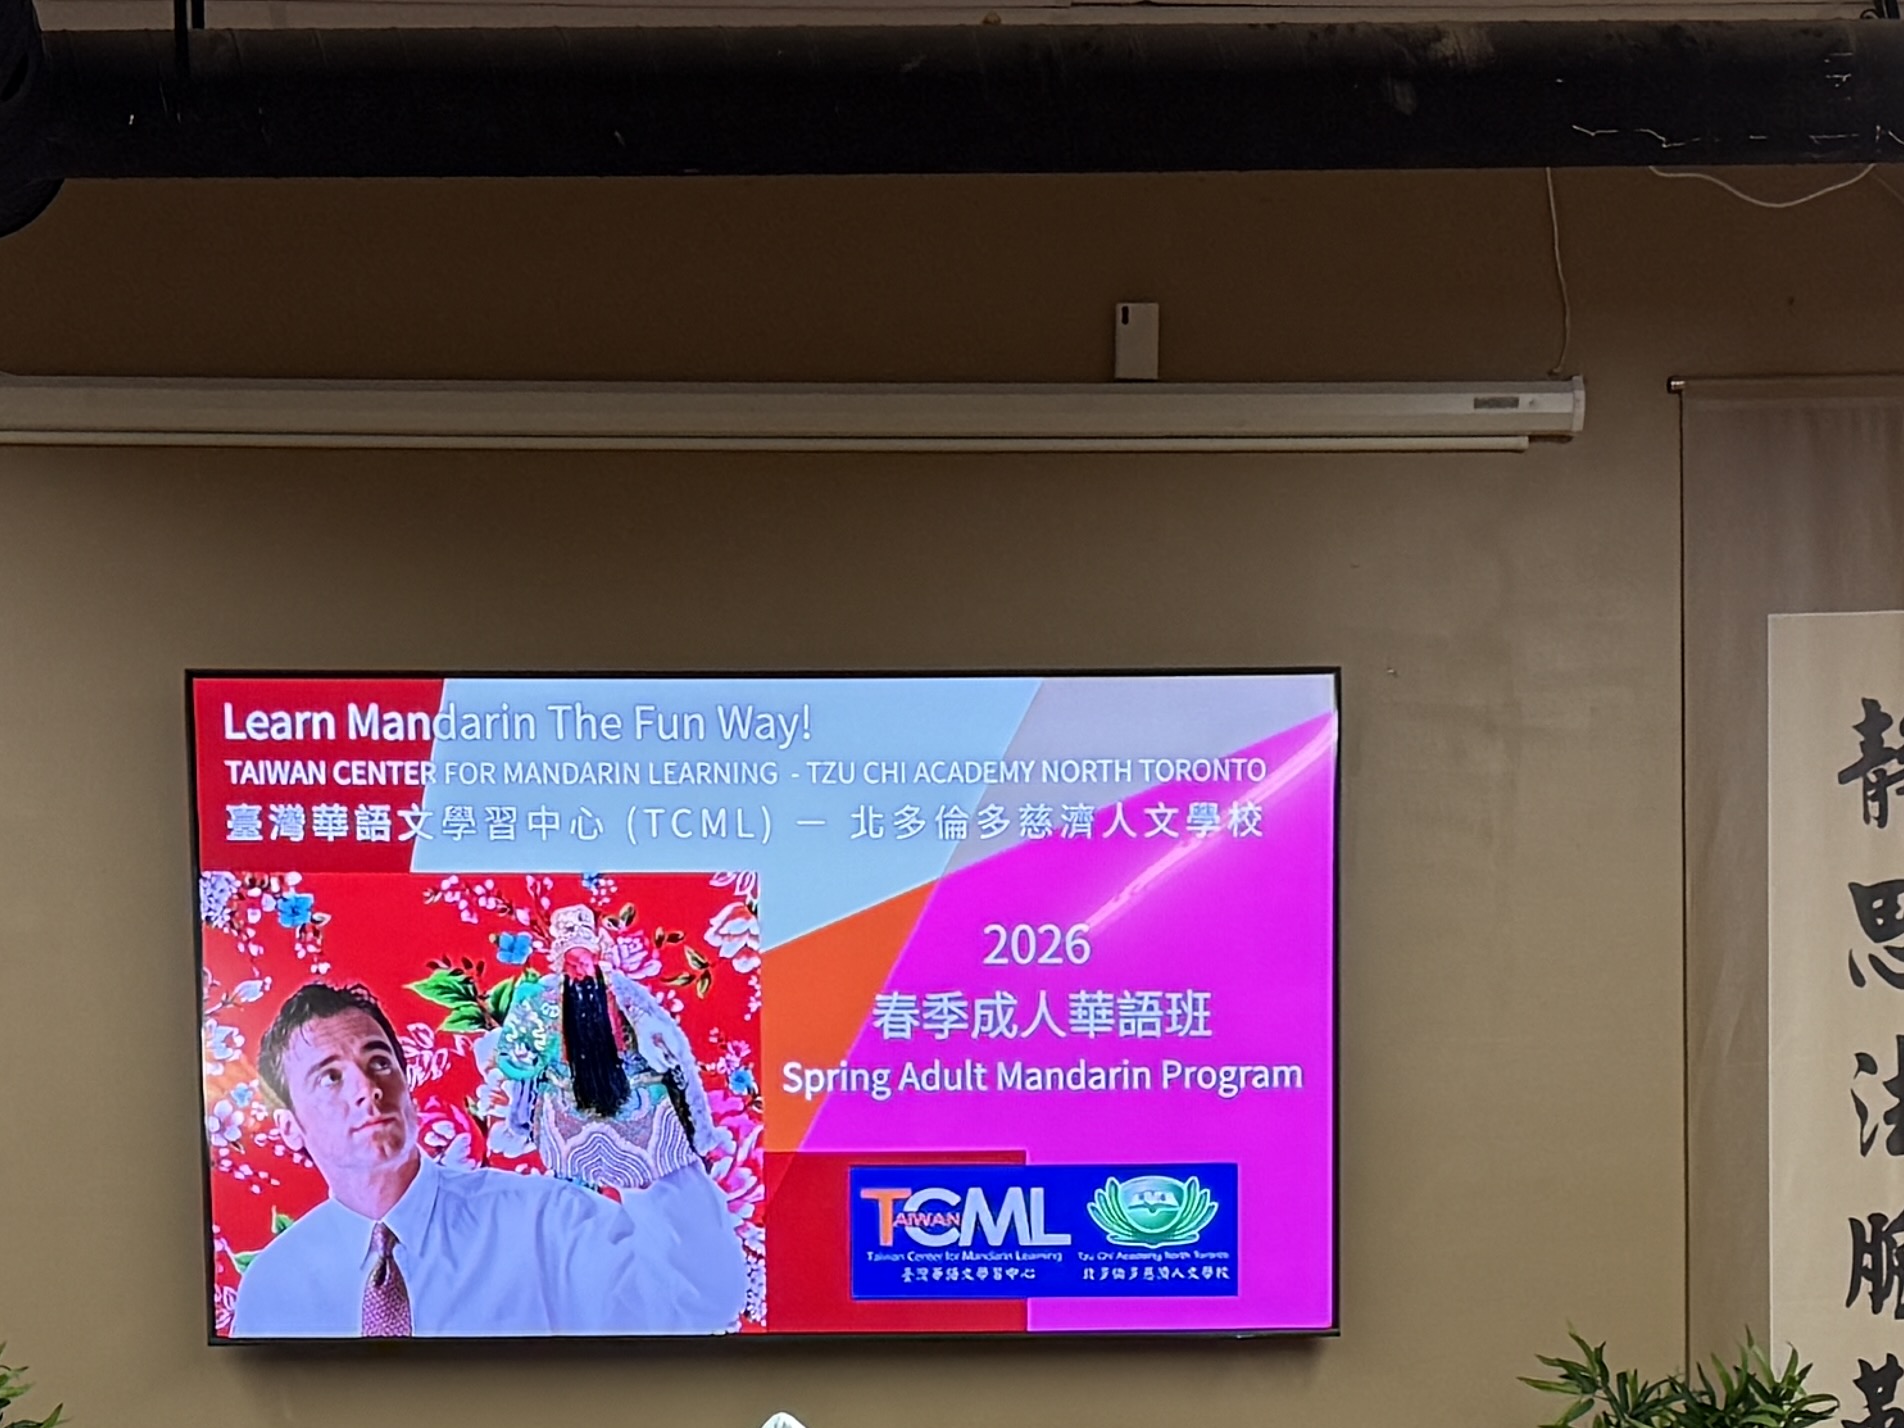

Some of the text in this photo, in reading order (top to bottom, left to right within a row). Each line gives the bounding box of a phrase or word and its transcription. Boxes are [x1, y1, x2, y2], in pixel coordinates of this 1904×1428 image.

[224, 702, 812, 750] Learn Mandarin The Fun Way!
[224, 759, 326, 786] TAIWAN
[332, 760, 436, 786] CENTER
[445, 761, 495, 786] FOR
[503, 761, 640, 786] MANDARIN
[648, 760, 778, 786] LEARNING
[805, 761, 856, 785] TZU
[862, 761, 907, 785] CHI
[913, 760, 1036, 785] ACADEMY
[1041, 759, 1132, 783] NORTH
[1138, 757, 1267, 783] TORONTO
[225, 801, 1265, 845] 臺灣華語文學習中心 (TCML) 北多倫多慈濟人文學校
[982, 923, 1092, 966] 2026
[872, 989, 1212, 1041] 春季成人華語班
[783, 1058, 1304, 1100] Spring Adult Mandarin Program
[860, 1186, 1072, 1248] TCML
[907, 1251, 944, 1262] Center
[962, 1251, 1013, 1262] Mandarin
[1015, 1251, 1063, 1263] Learning
